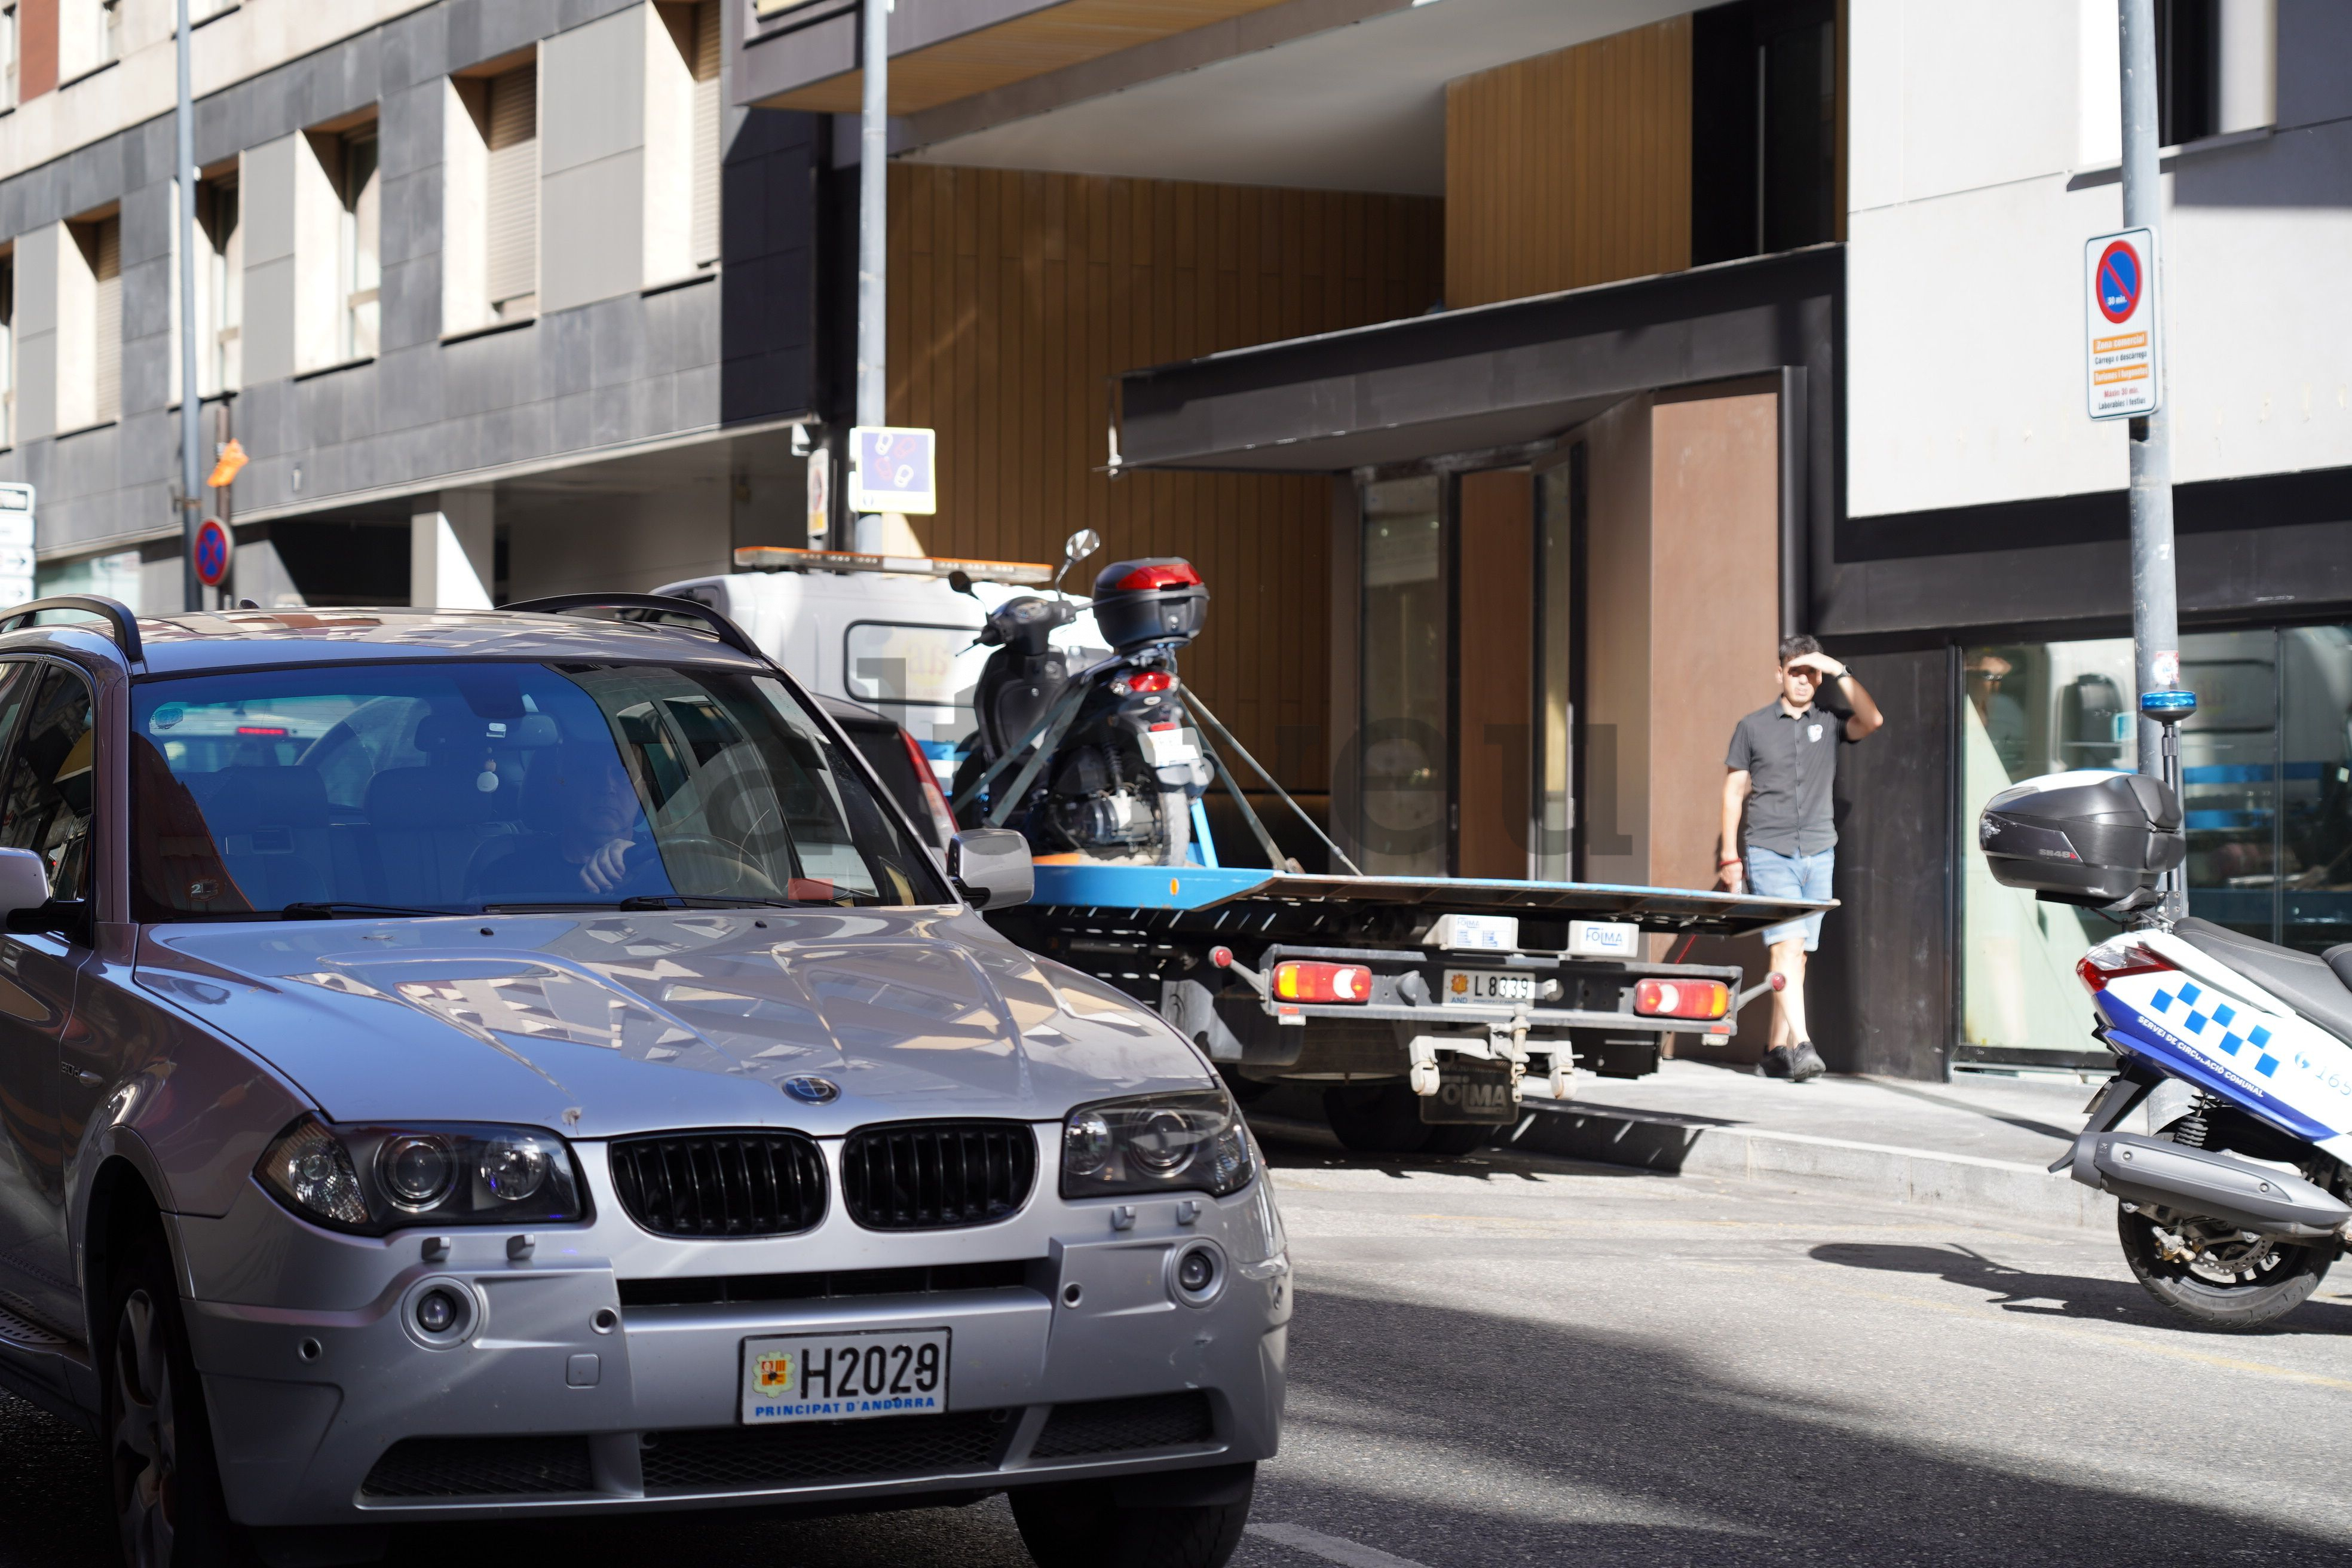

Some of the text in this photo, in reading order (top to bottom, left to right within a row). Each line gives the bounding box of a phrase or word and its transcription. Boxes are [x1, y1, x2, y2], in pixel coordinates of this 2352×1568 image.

[2108, 296, 2115, 306] 30
[2097, 333, 2144, 351] Zona comercial
[2121, 387, 2127, 396] 30
[2099, 400, 2125, 410] Laborables
[2129, 397, 2146, 406] festius
[2137, 1016, 2264, 1098] SERVEI DE CIRCULACIÓ COMUNAL
[801, 1343, 939, 1399] H2029
[755, 1396, 935, 1417] PRINCIPAT D'ANDORRA
